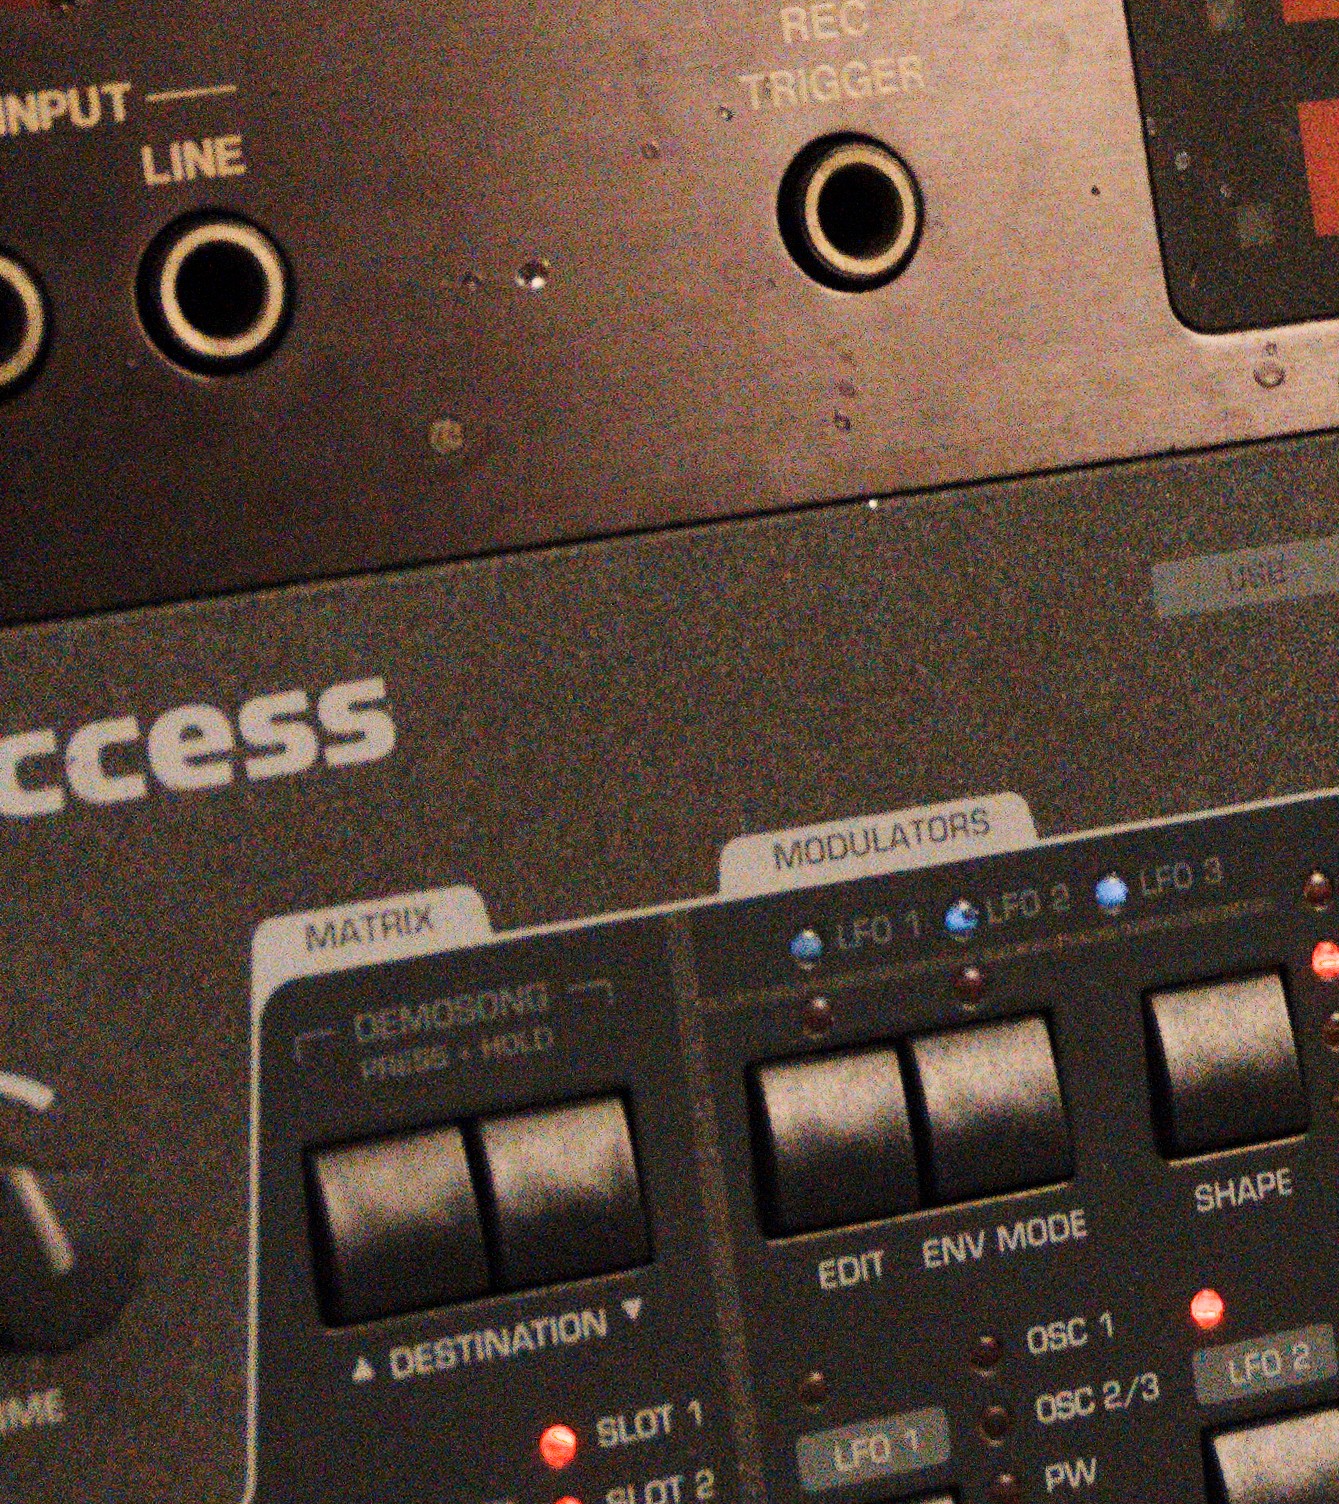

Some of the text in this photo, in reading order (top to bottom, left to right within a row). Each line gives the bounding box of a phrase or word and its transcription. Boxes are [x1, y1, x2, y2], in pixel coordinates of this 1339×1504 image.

[141, 135, 246, 185] LINE
[772, 809, 991, 869] MODULATORS
[304, 906, 433, 952] MATRIX
[1193, 1167, 1293, 1213] SHAPE
[818, 1209, 1088, 1290] EDIT ENV MODE
[389, 1307, 607, 1380] DESTINATION
[1227, 1340, 1311, 1386] LFO 2
[1035, 1371, 1161, 1424] OSC 2/3
[596, 1399, 703, 1448] SLOT 1
[834, 1430, 919, 1473] LFO 1
[695, 1469, 715, 1502] 2
[1044, 1459, 1097, 1492] PW
